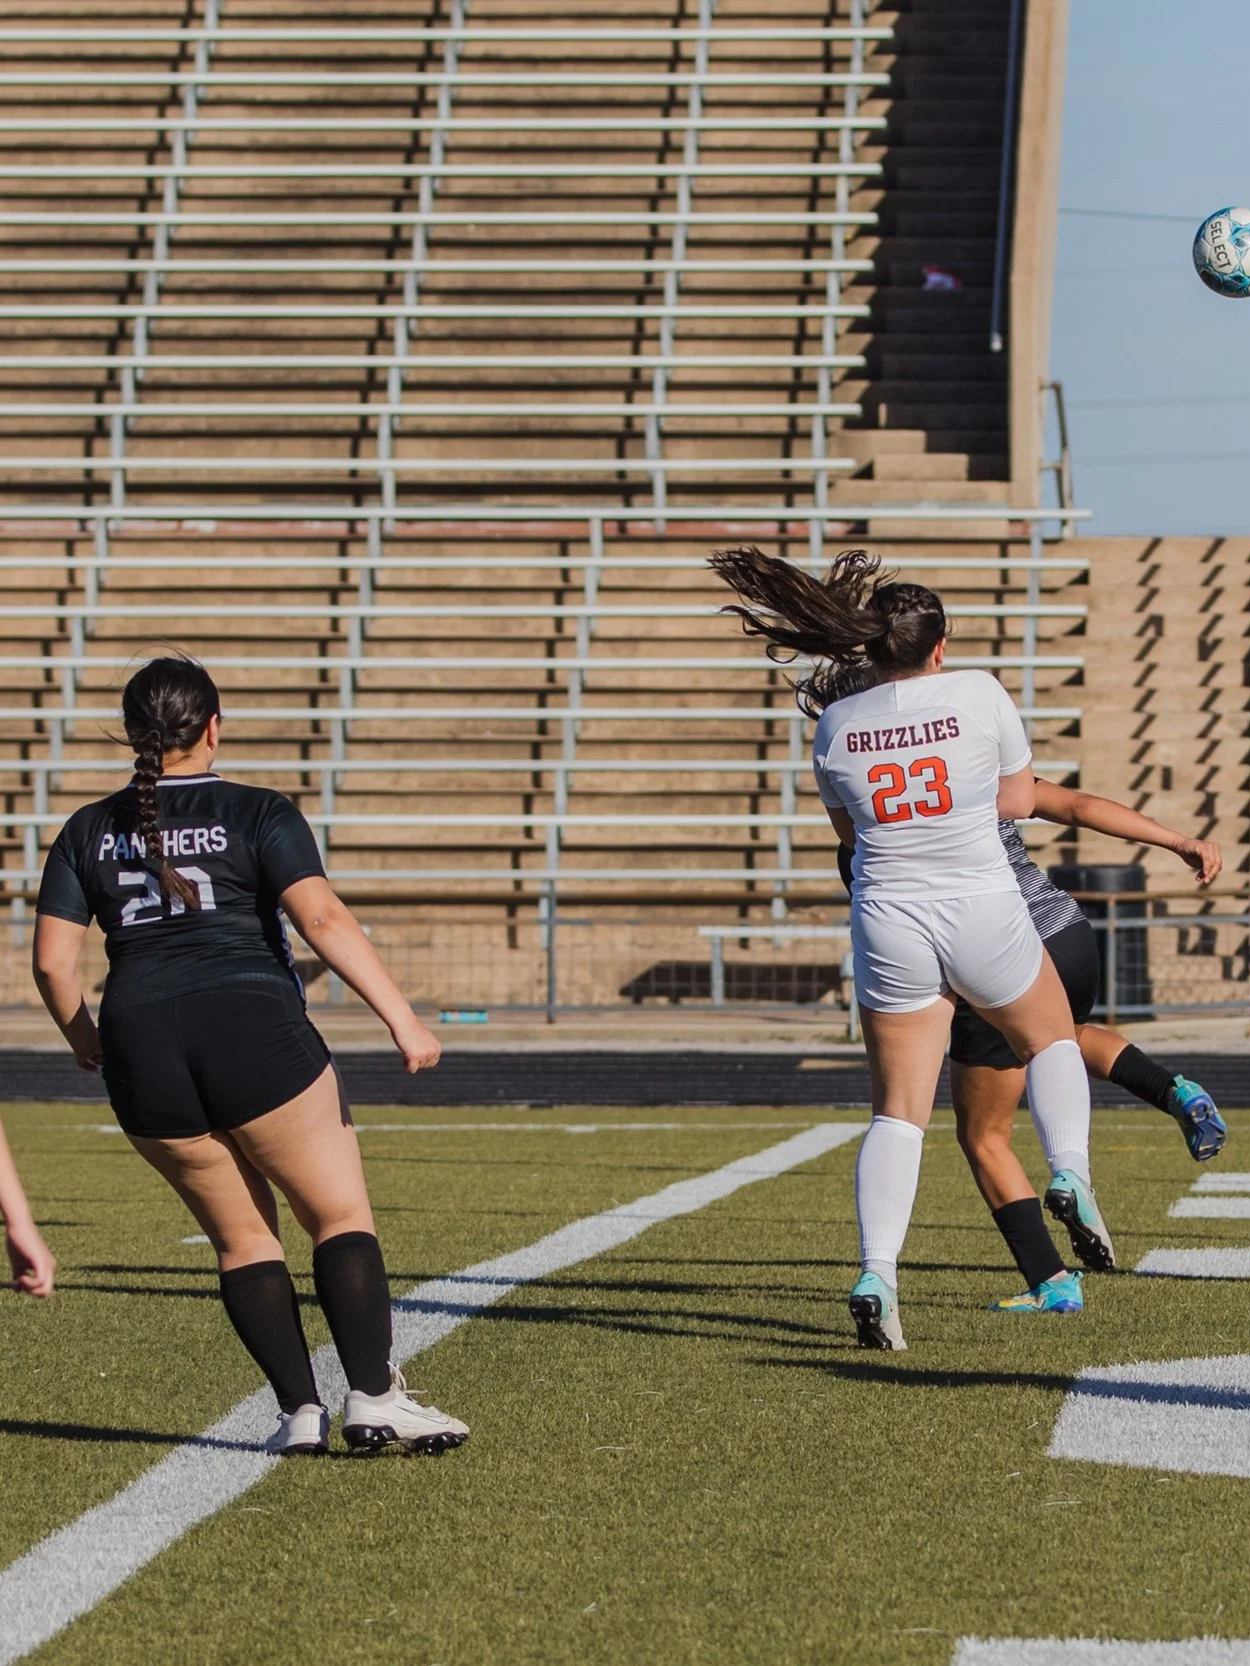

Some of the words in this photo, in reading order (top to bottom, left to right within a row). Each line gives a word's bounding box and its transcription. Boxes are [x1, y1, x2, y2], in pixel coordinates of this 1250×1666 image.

[1210, 221, 1231, 268] SELECT
[846, 716, 960, 753] GRIZZLIES
[867, 756, 953, 824] 23
[98, 825, 228, 861] PANHERS
